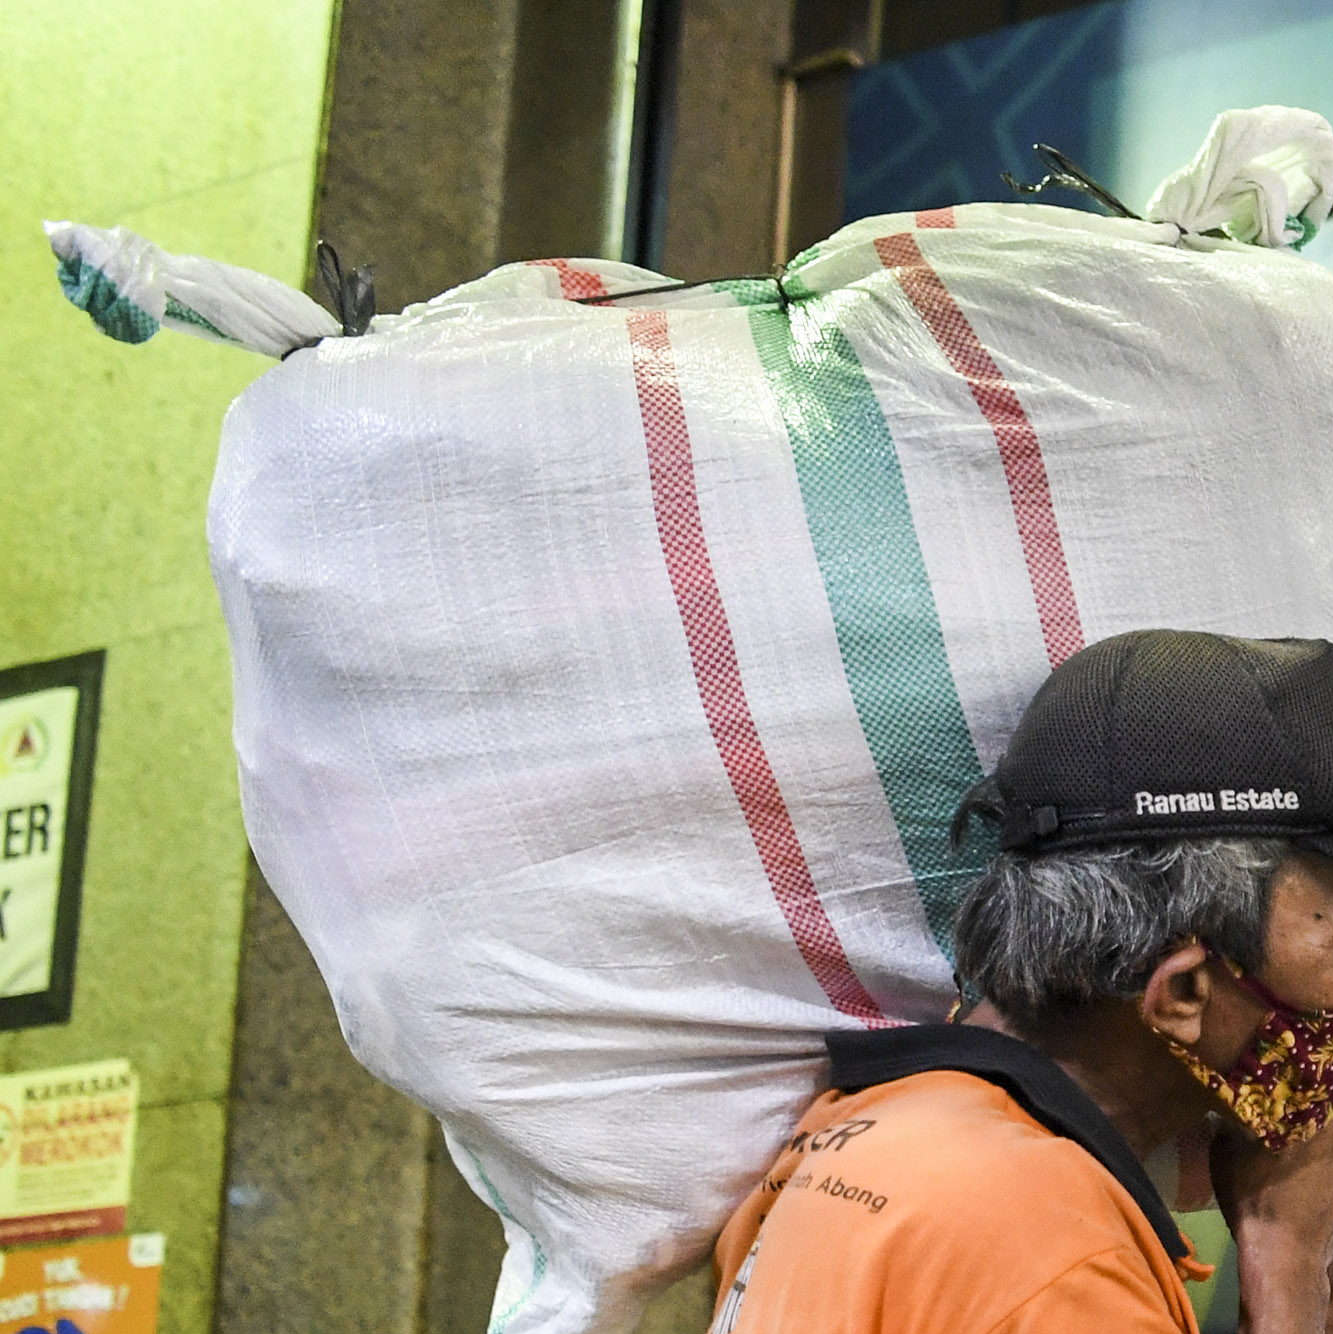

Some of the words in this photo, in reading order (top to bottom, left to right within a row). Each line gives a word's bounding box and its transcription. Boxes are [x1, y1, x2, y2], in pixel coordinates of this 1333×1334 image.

[1135, 791, 1215, 815] Ranau
[1220, 788, 1300, 811] Estate
[816, 1175, 888, 1213] Abang
